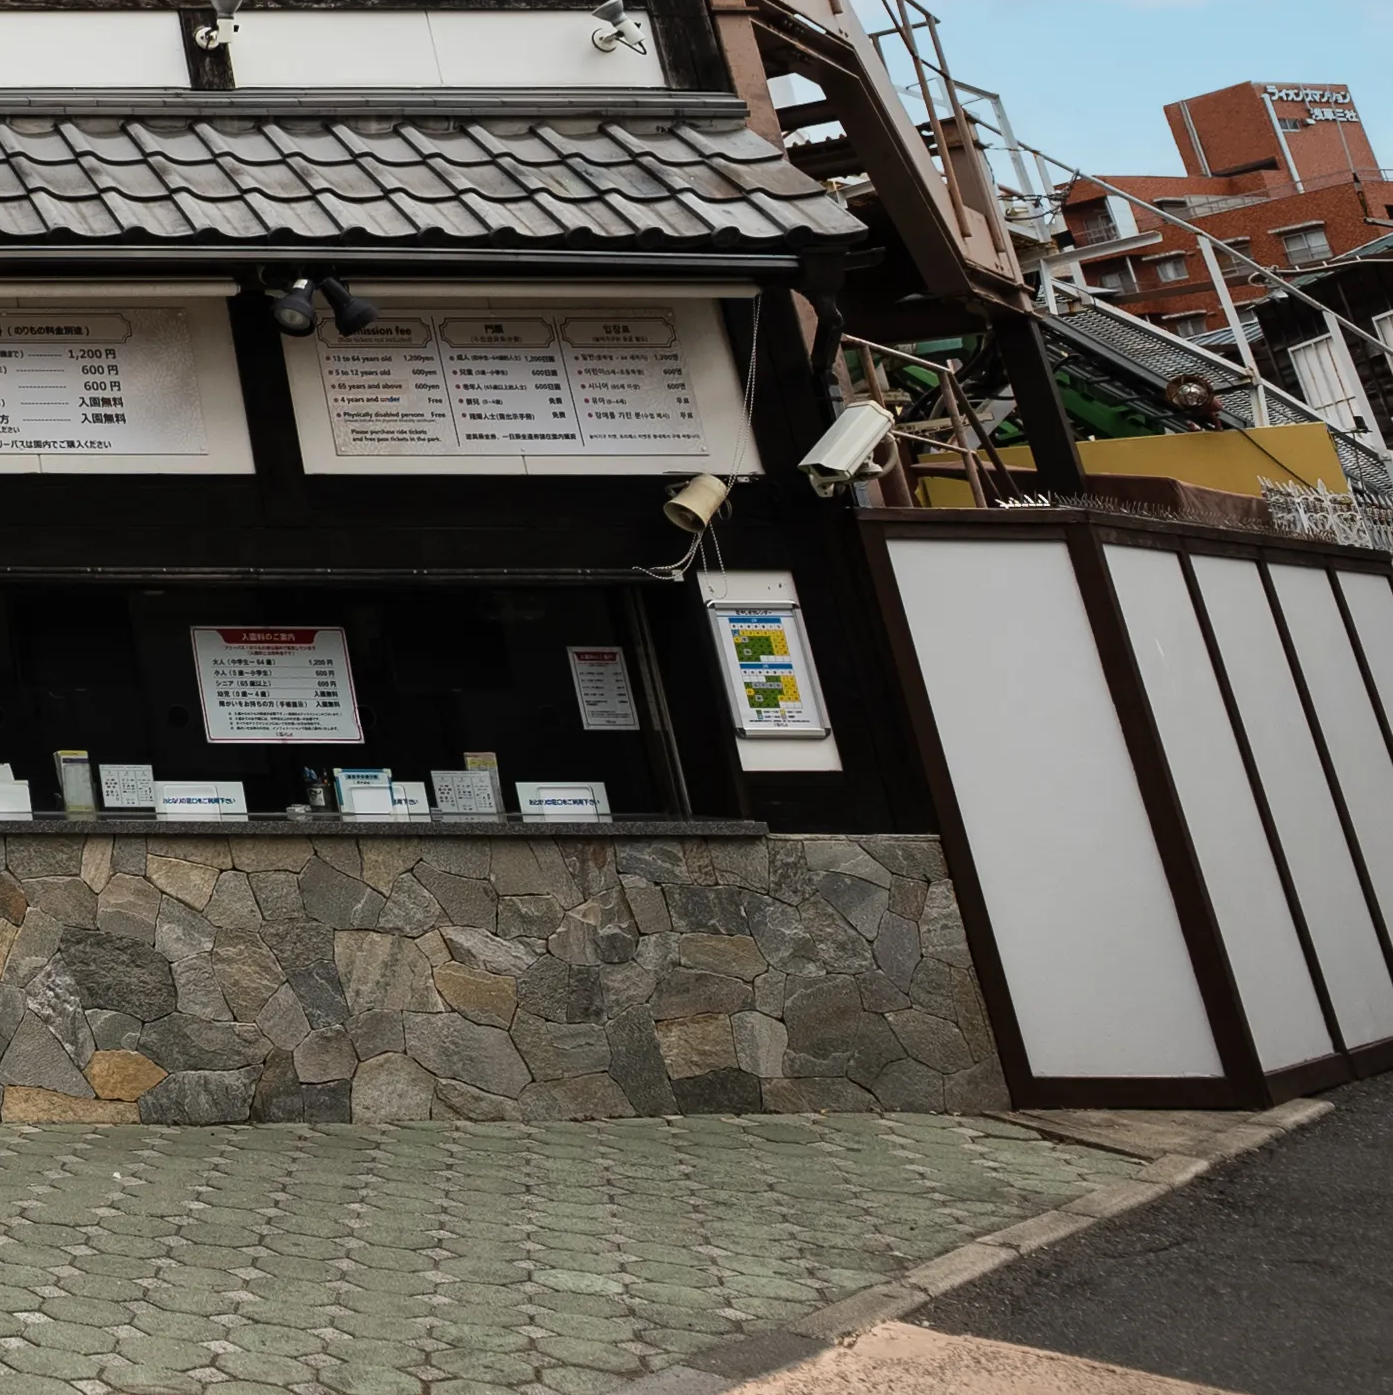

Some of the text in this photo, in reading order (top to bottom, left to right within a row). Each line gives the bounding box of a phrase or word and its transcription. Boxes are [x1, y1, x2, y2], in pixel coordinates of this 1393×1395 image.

[395, 326, 412, 335] fee
[68, 348, 117, 360] 1,200円
[361, 356, 380, 364] years
[81, 364, 119, 375] 600円
[360, 370, 378, 378] years
[411, 369, 437, 378] 600yen
[83, 380, 122, 392] 600円
[348, 384, 366, 392] years
[414, 383, 440, 392] 600yen
[78, 397, 124, 408] 入園無料
[347, 397, 365, 405] years
[81, 413, 127, 424] 入園無料
[343, 411, 373, 419] Physically
[370, 429, 395, 437] purchase
[242, 632, 296, 642] 入園料のご案内
